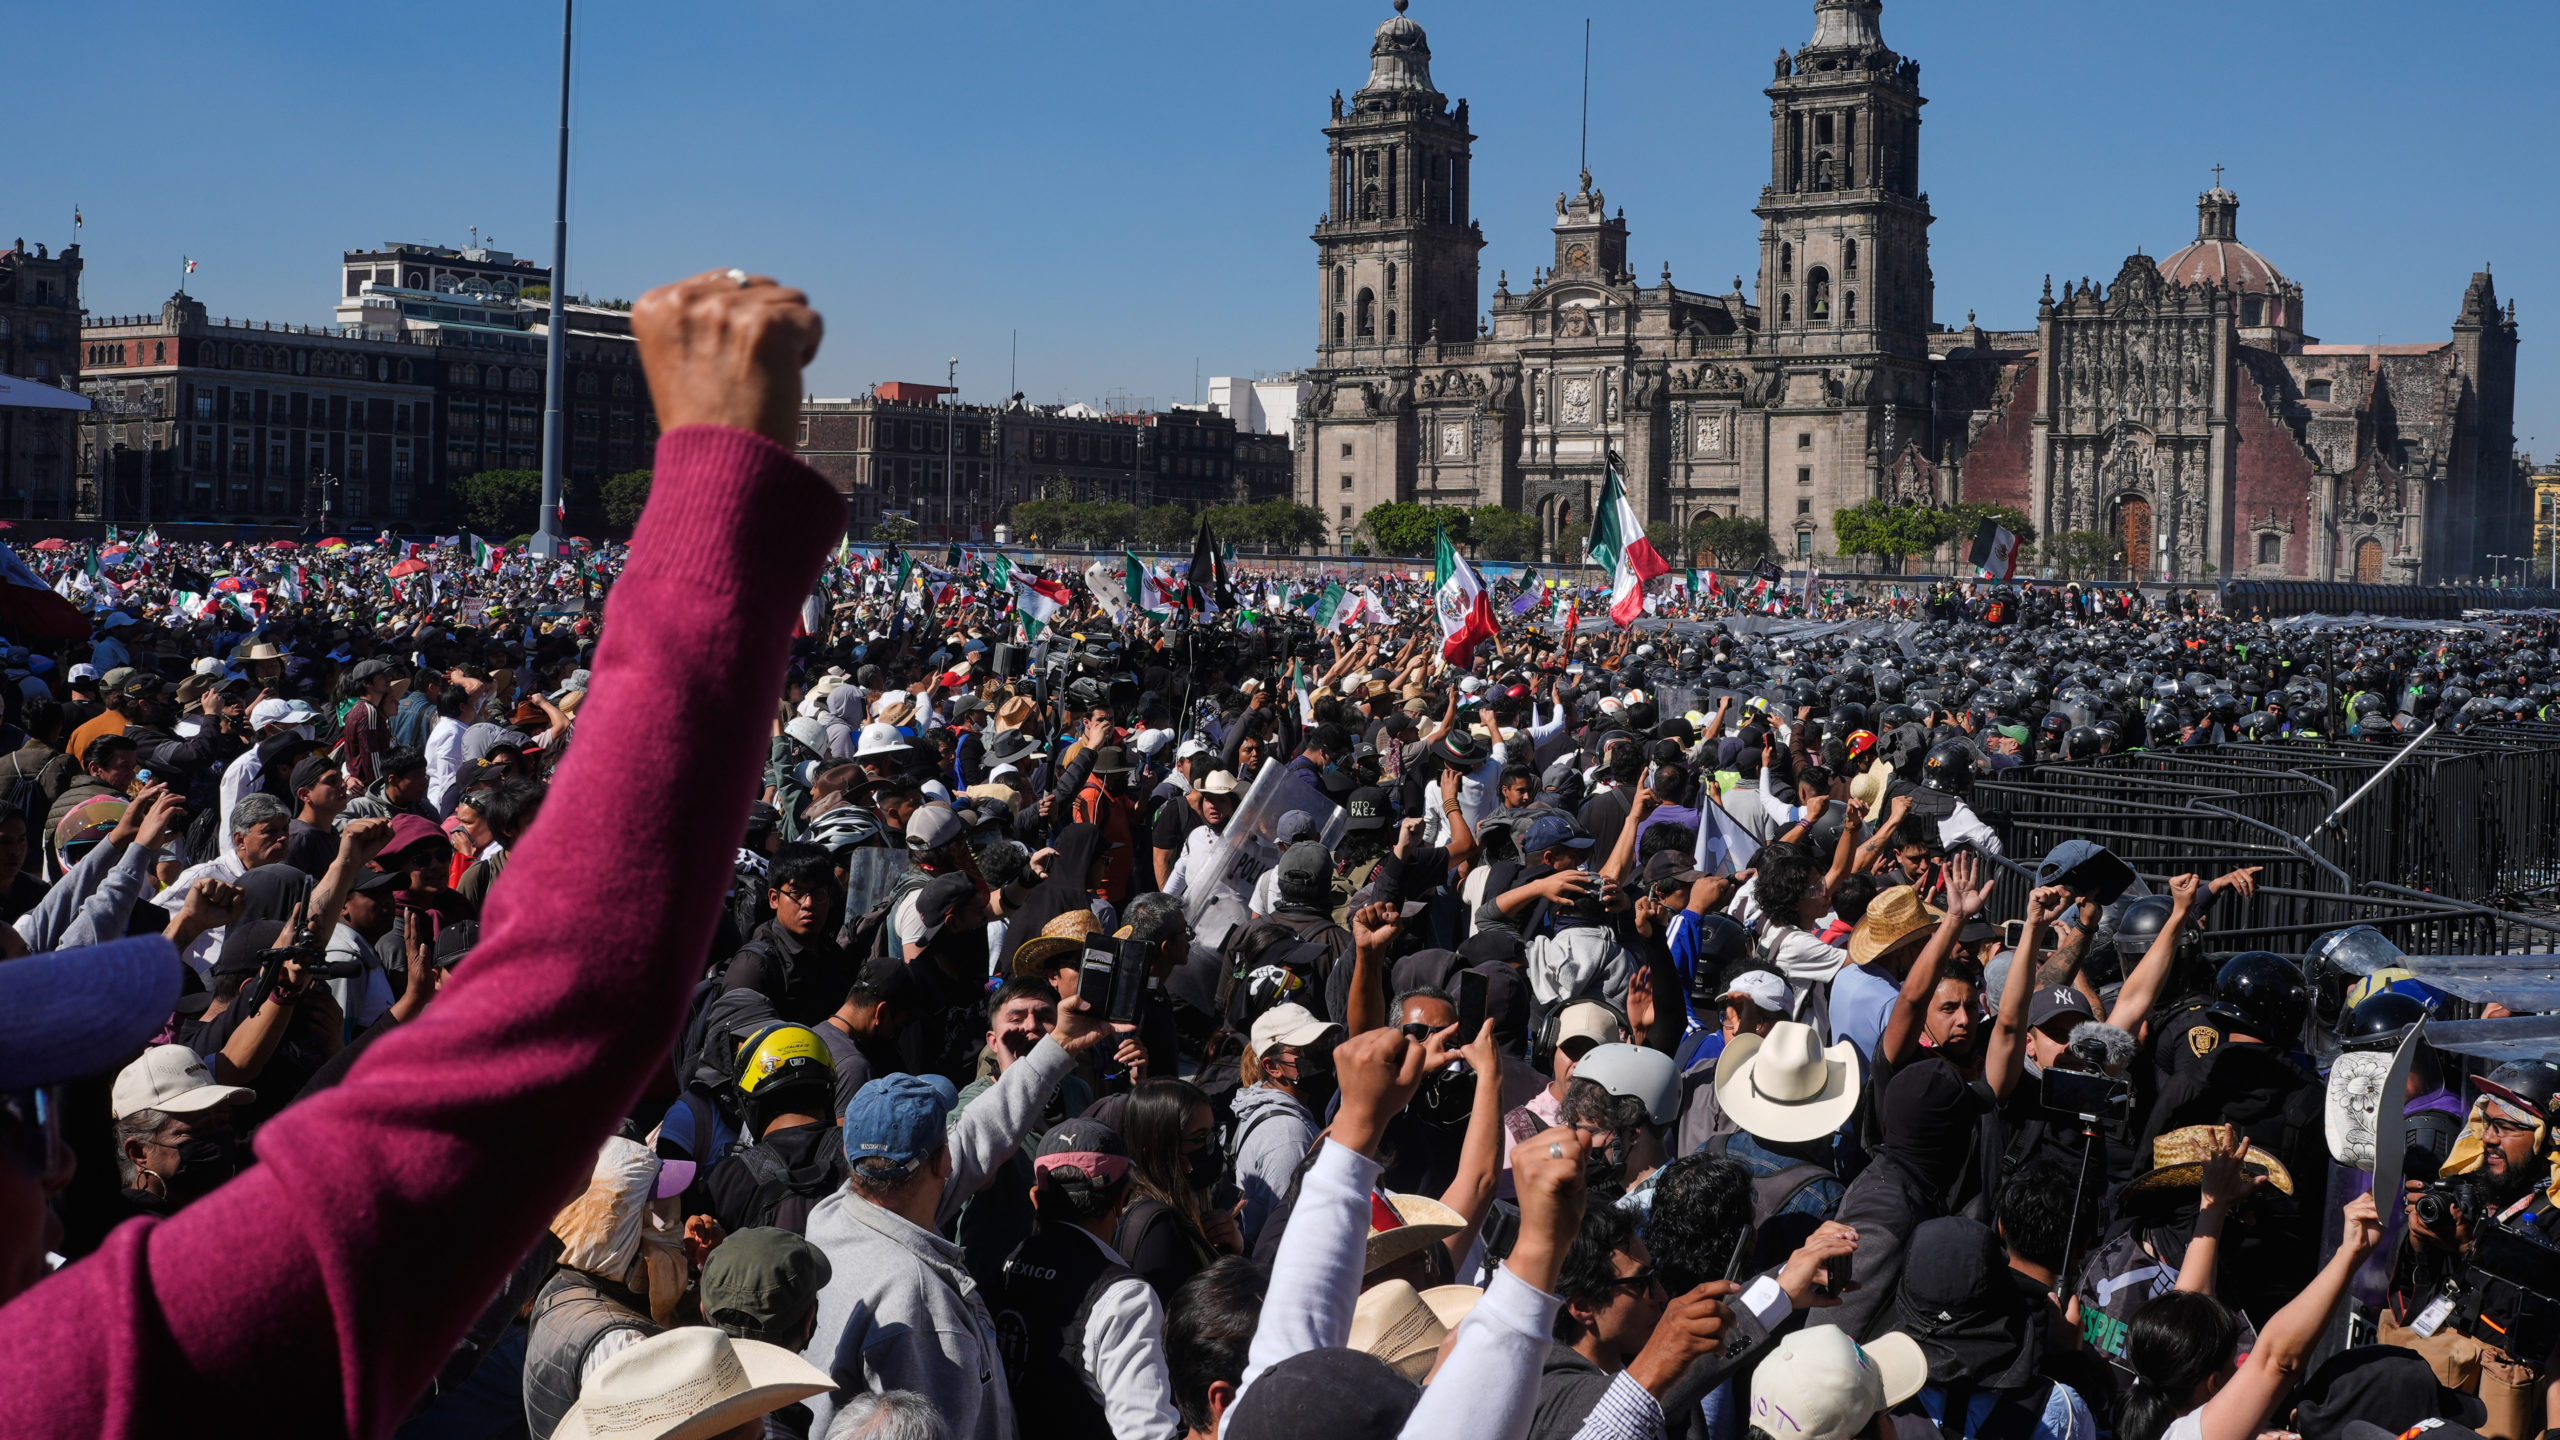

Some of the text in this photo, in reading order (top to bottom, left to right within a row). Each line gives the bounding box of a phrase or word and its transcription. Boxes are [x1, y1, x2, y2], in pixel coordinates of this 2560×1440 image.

[1351, 808, 1376, 816] PAEZ
[1233, 852, 1271, 886] POLI
[2054, 988, 2074, 1005] NY
[1003, 1259, 1057, 1280] MÉXICO
[2079, 1304, 2127, 1359] SPIE
